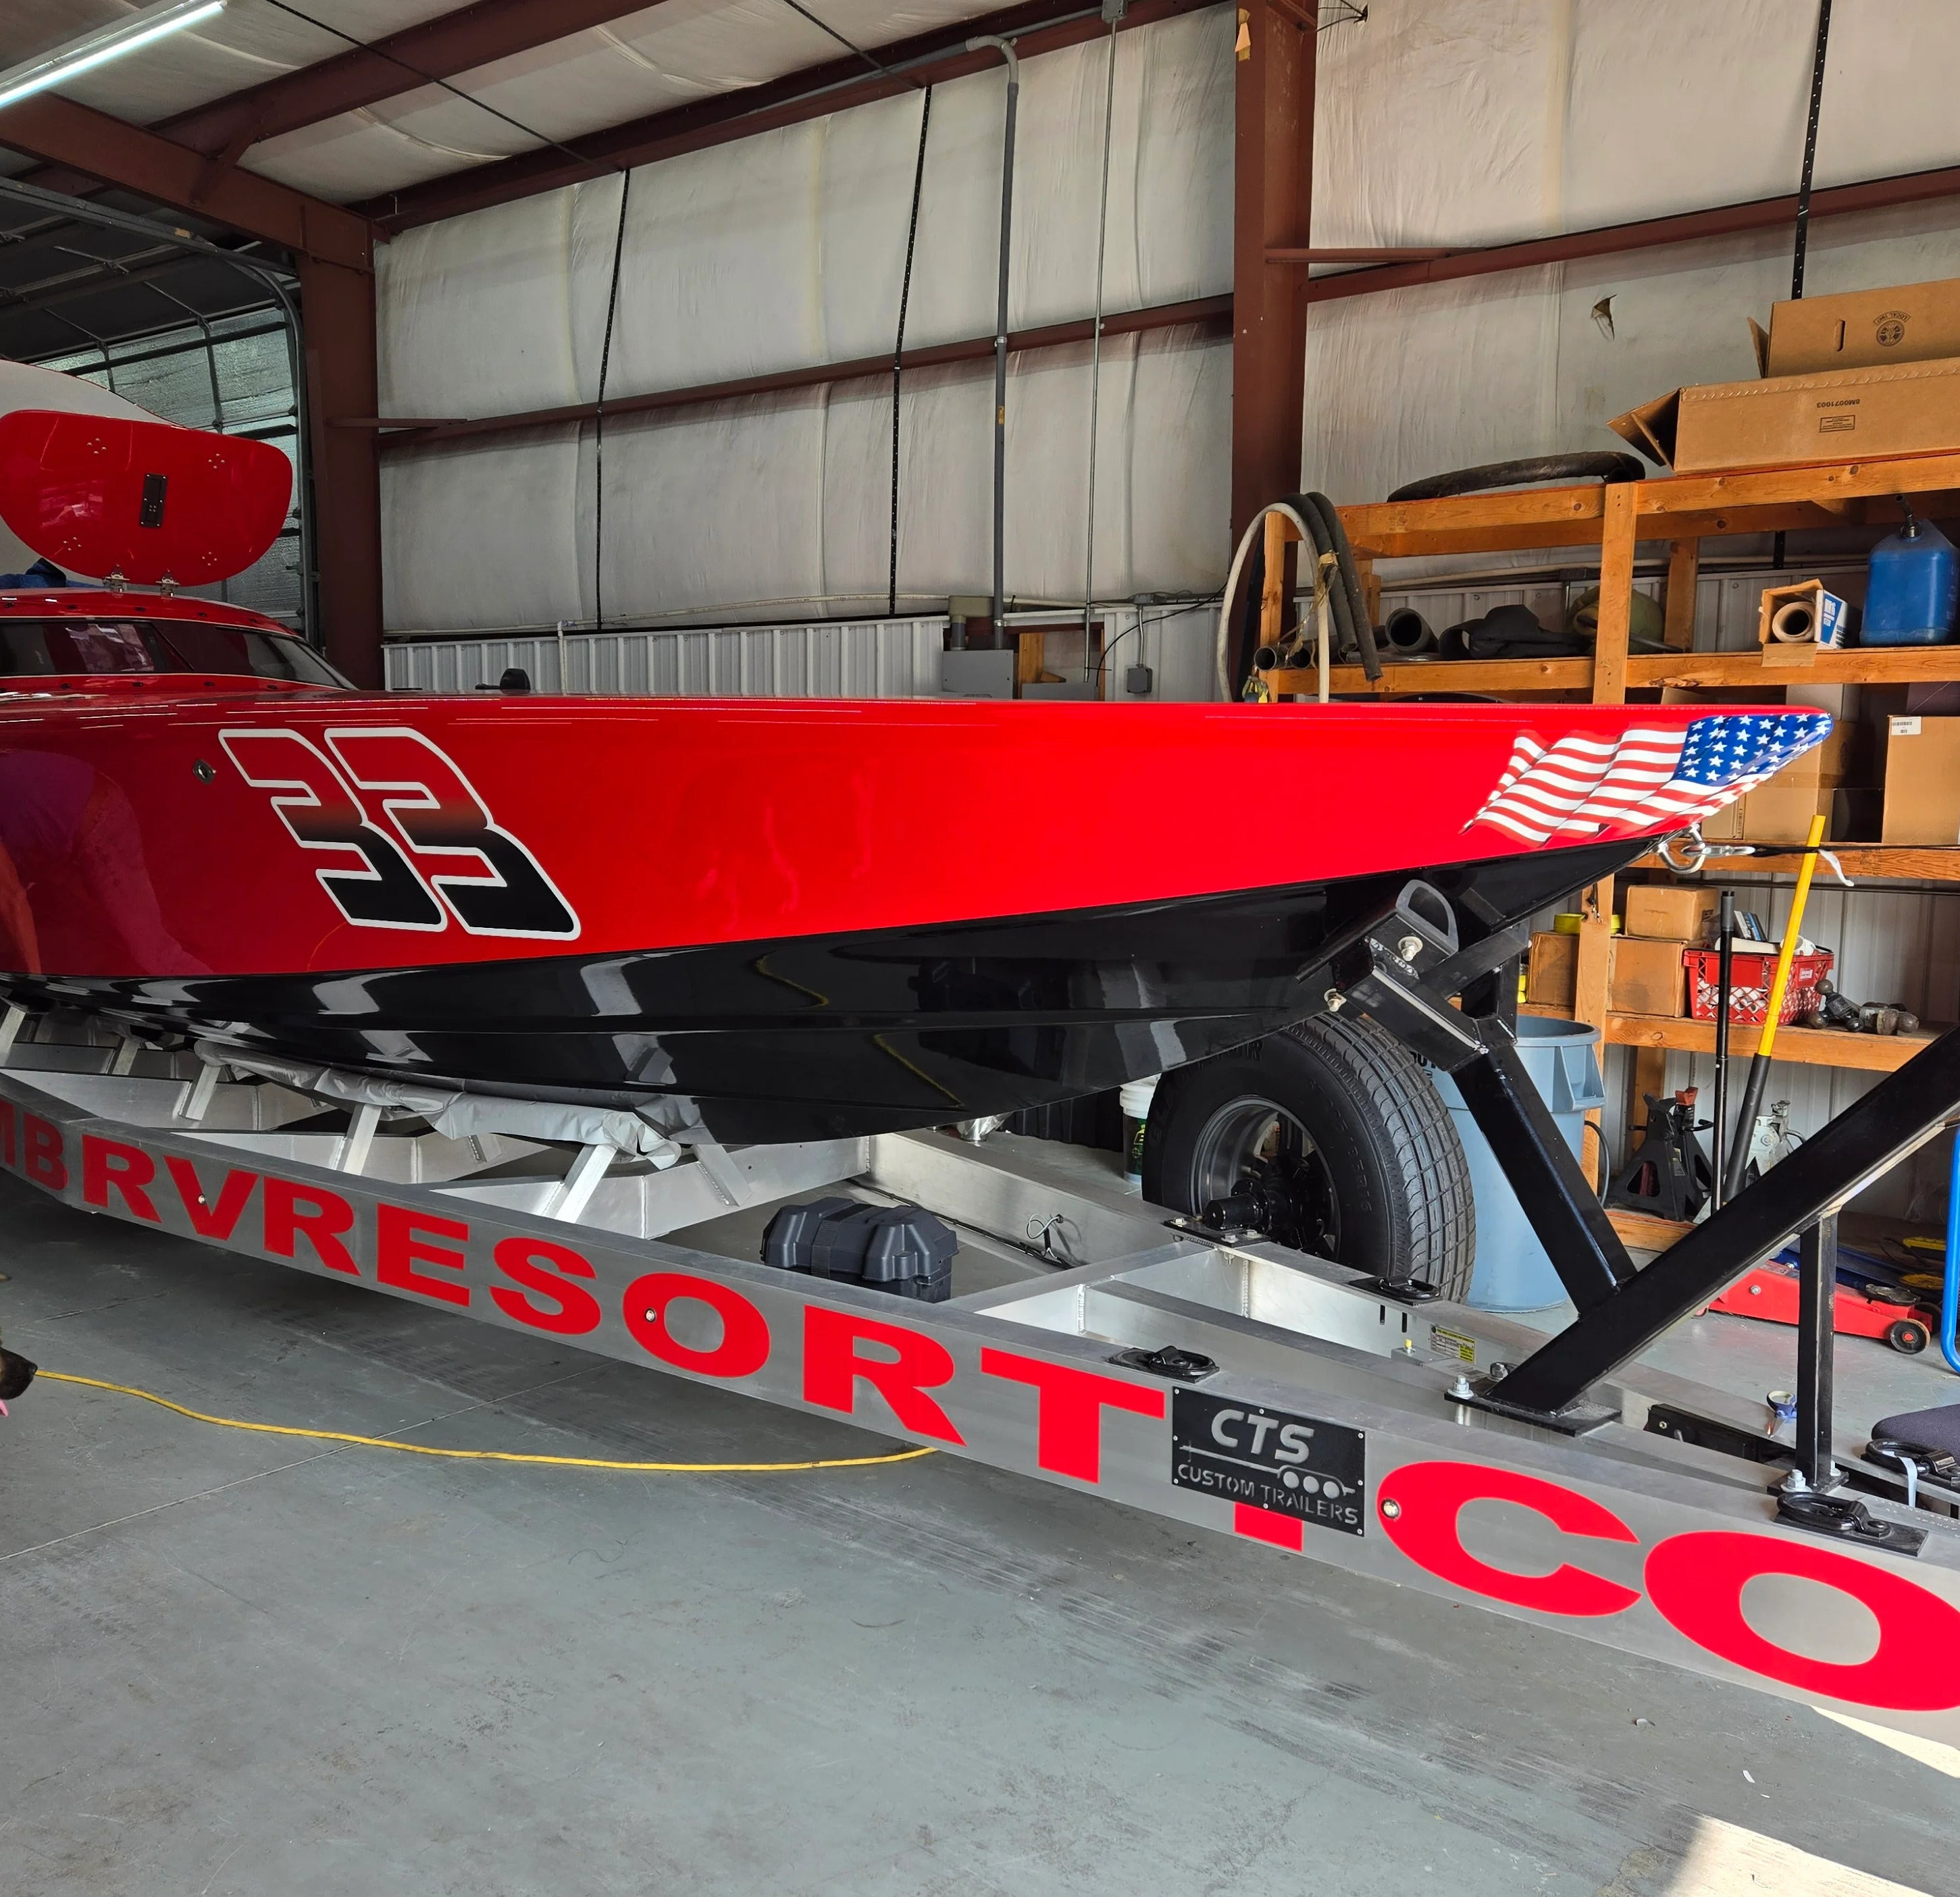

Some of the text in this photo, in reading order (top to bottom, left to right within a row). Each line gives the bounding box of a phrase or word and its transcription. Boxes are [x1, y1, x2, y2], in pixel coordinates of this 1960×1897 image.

[1889, 312, 1908, 321] LOCAL
[1816, 398, 1861, 408] 8M0071003
[218, 727, 581, 941] 33
[1211, 1409, 1315, 1464] CTS
[1177, 1463, 1358, 1525] CUSTOM TRAILERS
